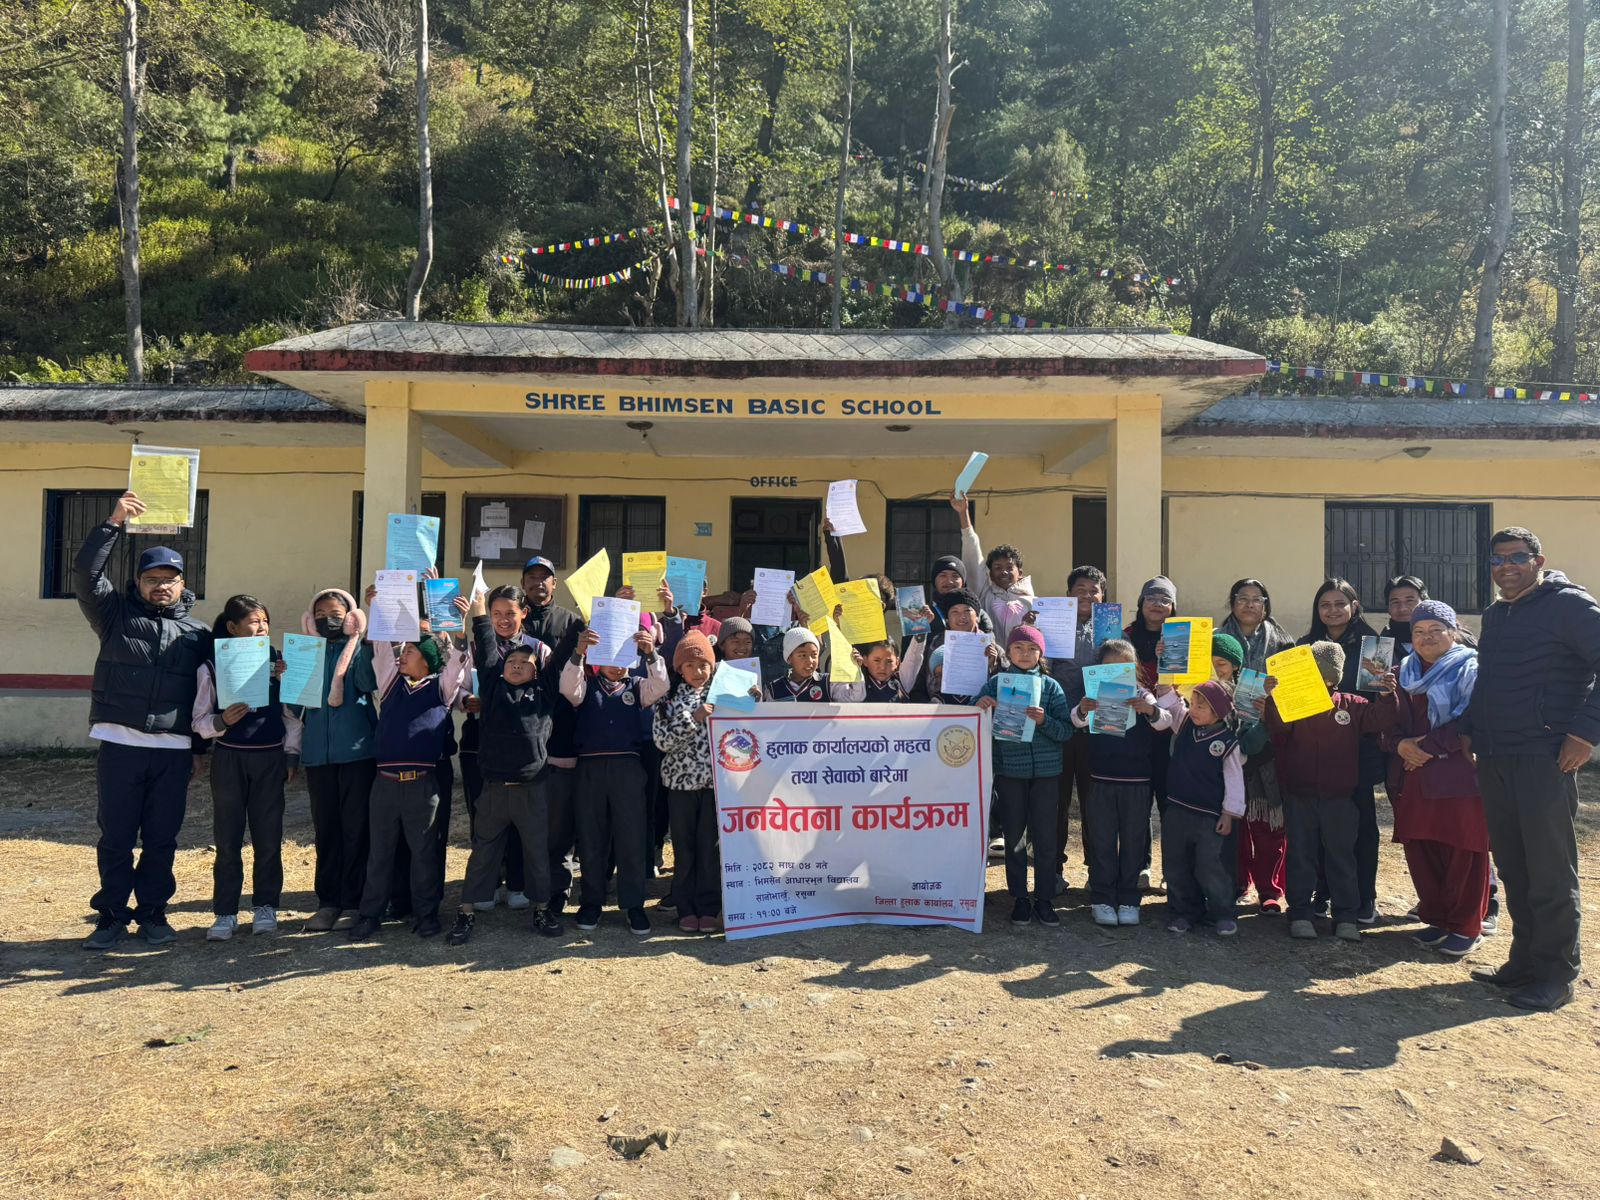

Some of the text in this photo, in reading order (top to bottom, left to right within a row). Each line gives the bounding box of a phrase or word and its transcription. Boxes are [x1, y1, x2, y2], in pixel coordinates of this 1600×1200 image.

[525, 392, 941, 416] SHREE BHIMSEN BASIC SCHOOL
[750, 476, 798, 488] OFFICE
[766, 741, 808, 758] हुलाक
[812, 736, 889, 755] कार्यालयको
[893, 738, 931, 753] महत्व
[791, 765, 909, 785] तथा सेवाको बारेमा
[721, 796, 970, 833] जनचेतना कार्यक्रम
[725, 862, 742, 874] मिति
[752, 861, 774, 872] २०८२
[778, 861, 795, 870] माघ
[815, 860, 828, 870] गते
[726, 879, 744, 889] स्थान
[754, 875, 782, 887] भिमसेन
[785, 875, 823, 887] आधारभूत
[827, 875, 859, 884] विद्यालय
[912, 880, 942, 891] आयोजक
[728, 912, 746, 923] समय
